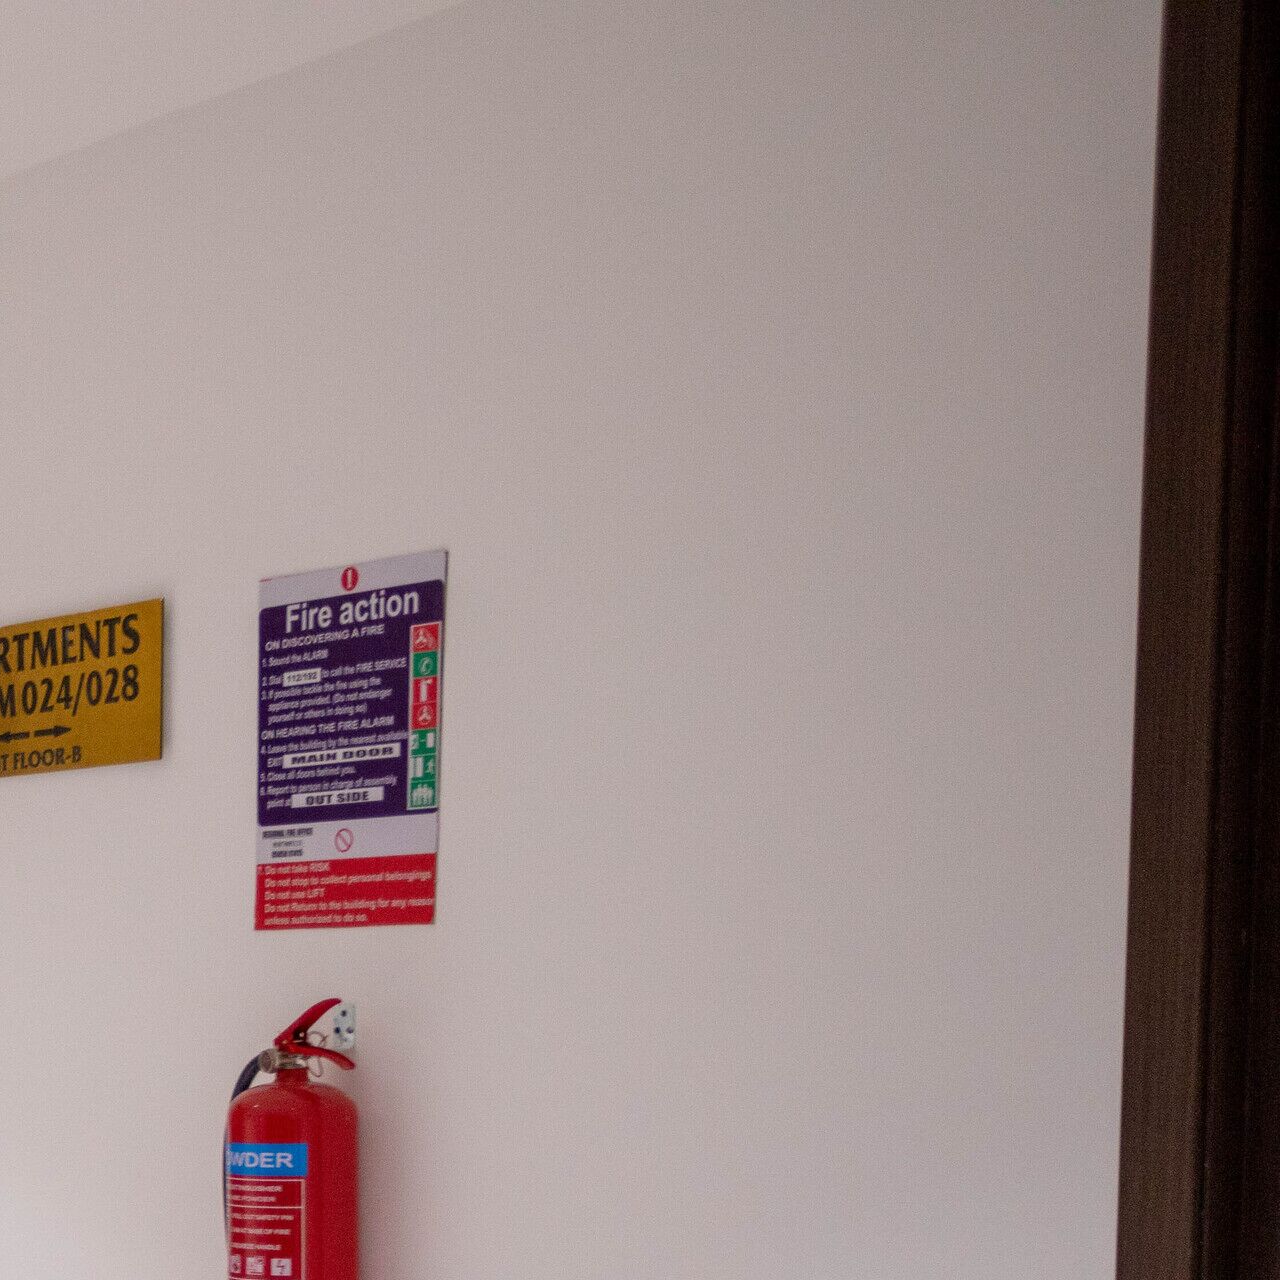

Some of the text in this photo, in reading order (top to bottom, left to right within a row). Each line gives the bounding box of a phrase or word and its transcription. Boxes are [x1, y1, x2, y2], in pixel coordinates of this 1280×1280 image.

[285, 591, 420, 634] Fire action
[265, 624, 384, 651] ON DISCOVERING A FIRE
[22, 664, 140, 717] 024/028
[261, 715, 394, 740] ON HEARING THE FIRE ALARM
[290, 752, 336, 764] MAIN
[342, 746, 393, 759] DOOR
[305, 794, 332, 805] OUT
[336, 790, 369, 802] SIDE
